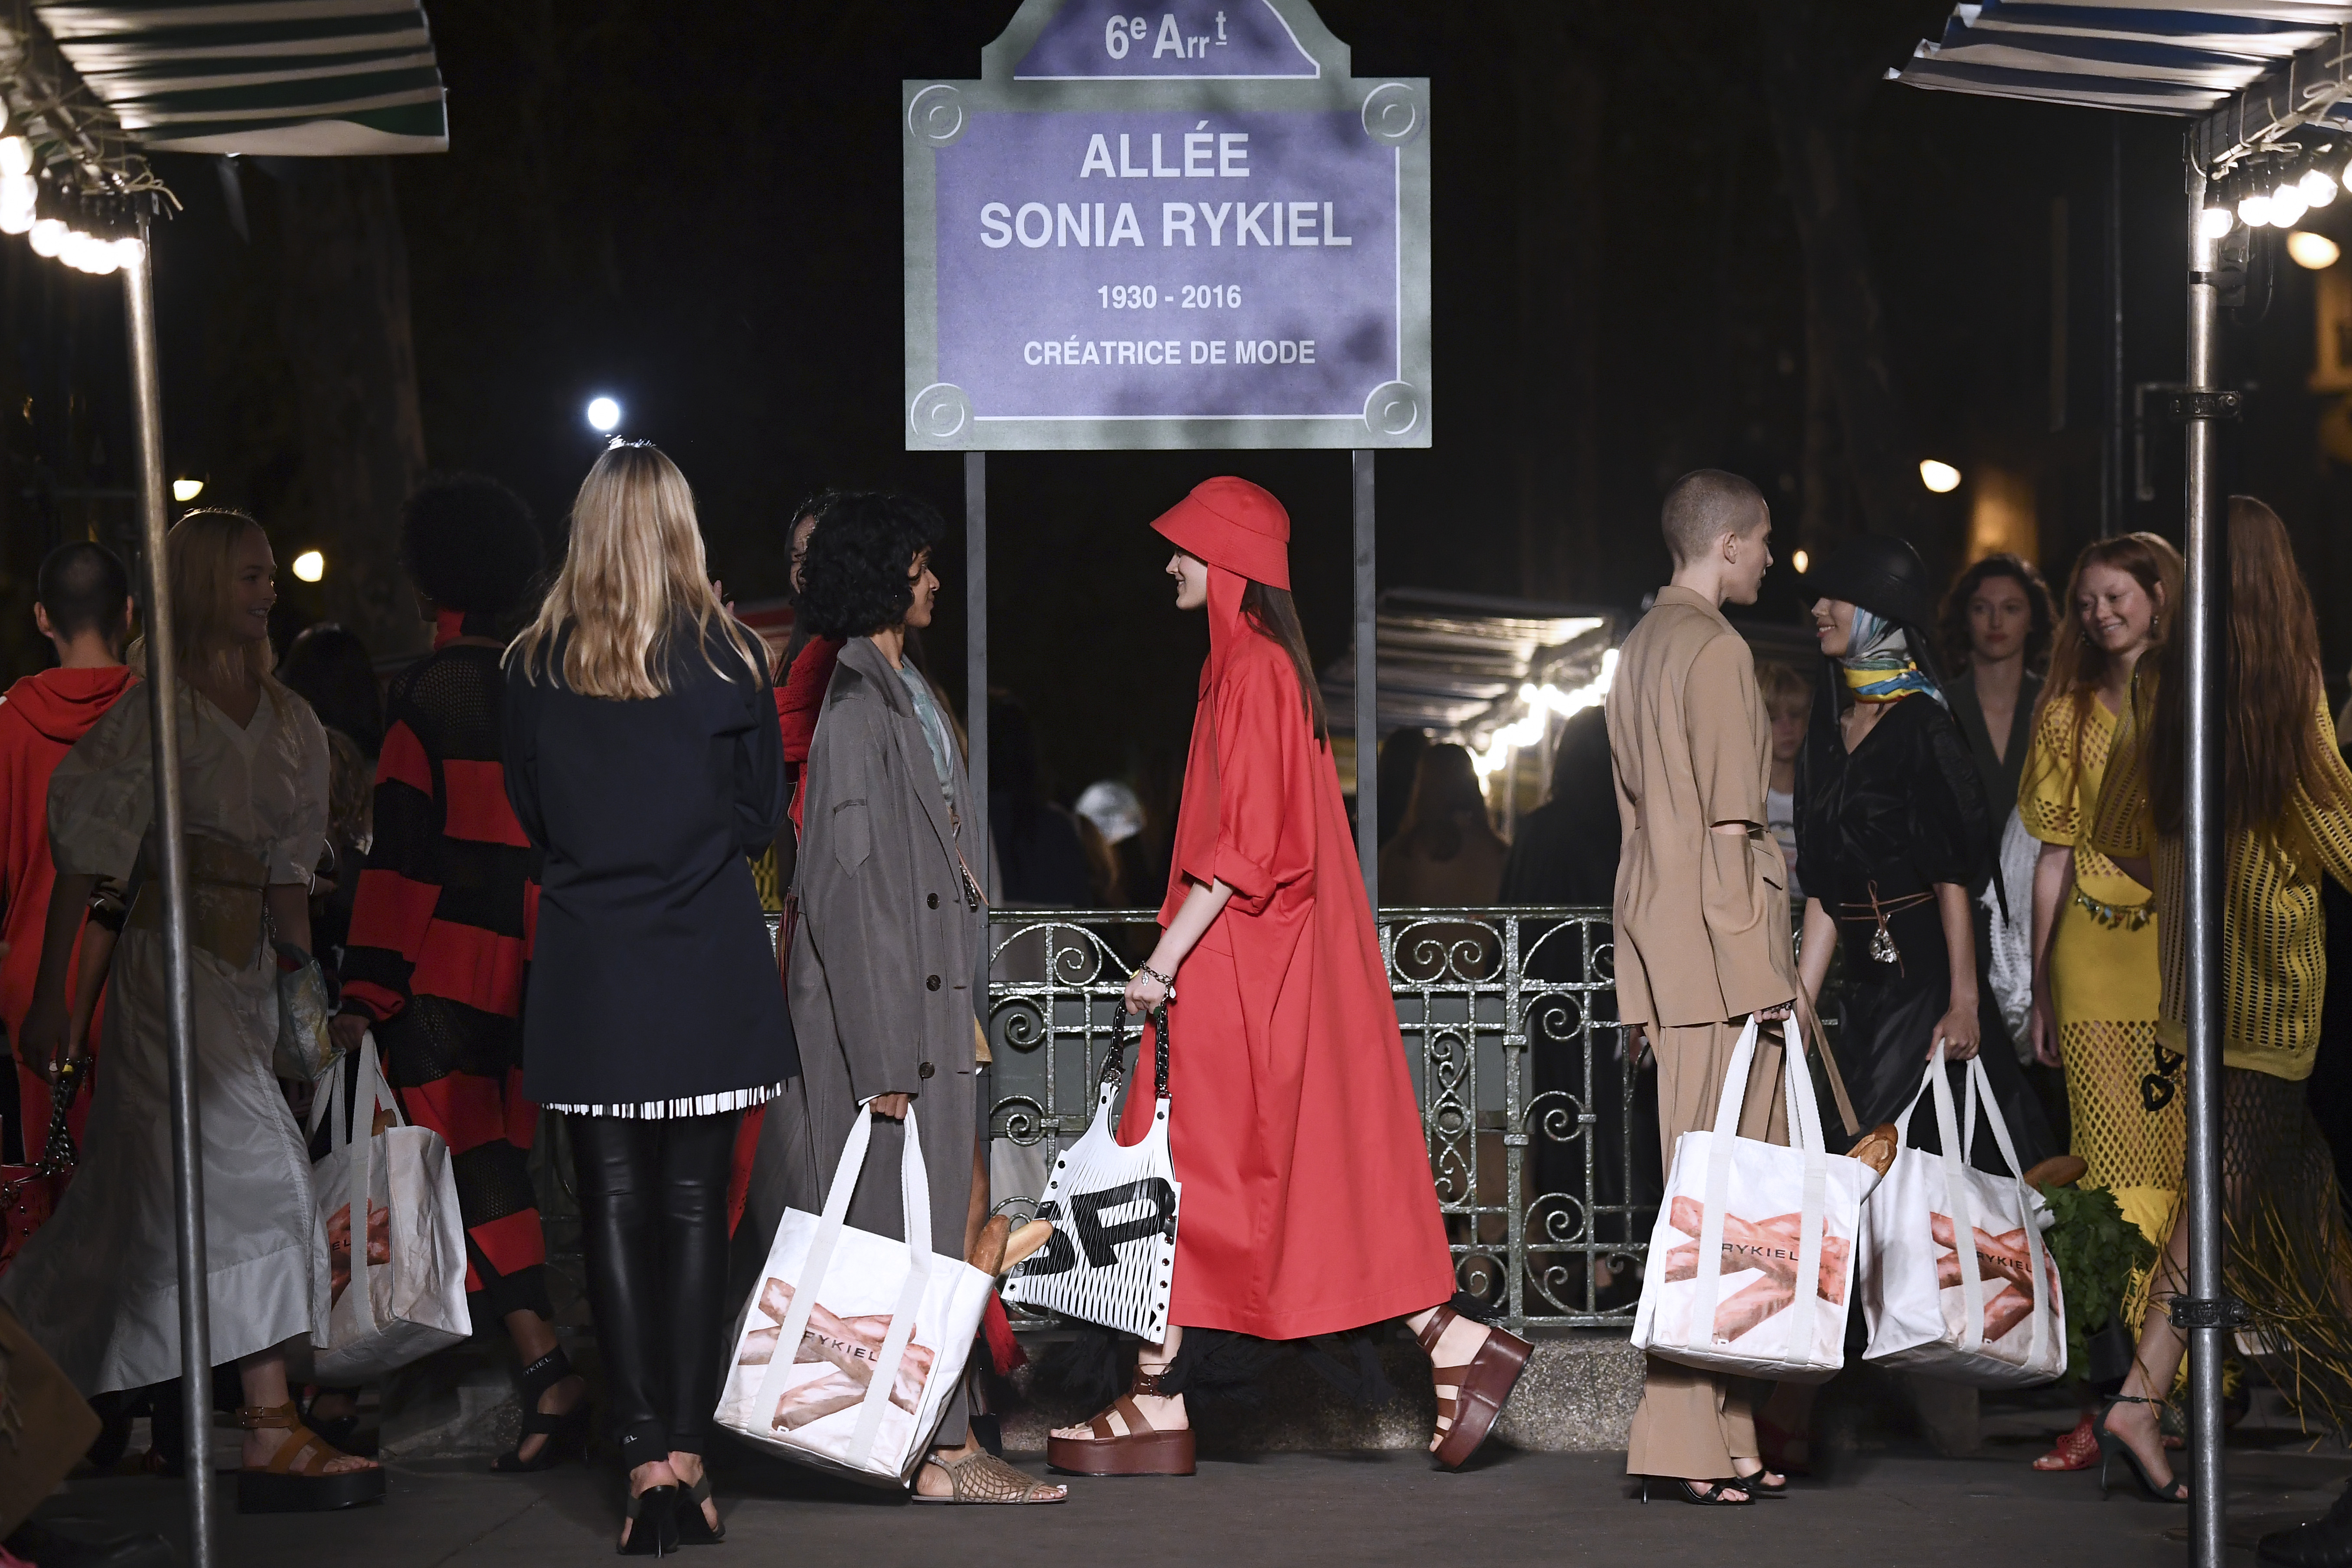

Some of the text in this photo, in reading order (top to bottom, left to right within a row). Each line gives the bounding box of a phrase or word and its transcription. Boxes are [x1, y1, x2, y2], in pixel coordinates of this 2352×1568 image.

[1080, 120, 1250, 178] ALLÉE
[980, 202, 1352, 248] SONIA RYKIEL
[1098, 286, 1157, 309] 1930
[1182, 285, 1242, 309] 2016
[1024, 334, 1316, 366] CRÉATRICE DE MODE
[1722, 1243, 1799, 1261] RYKIEL
[1976, 1251, 2032, 1273] RYKIEL
